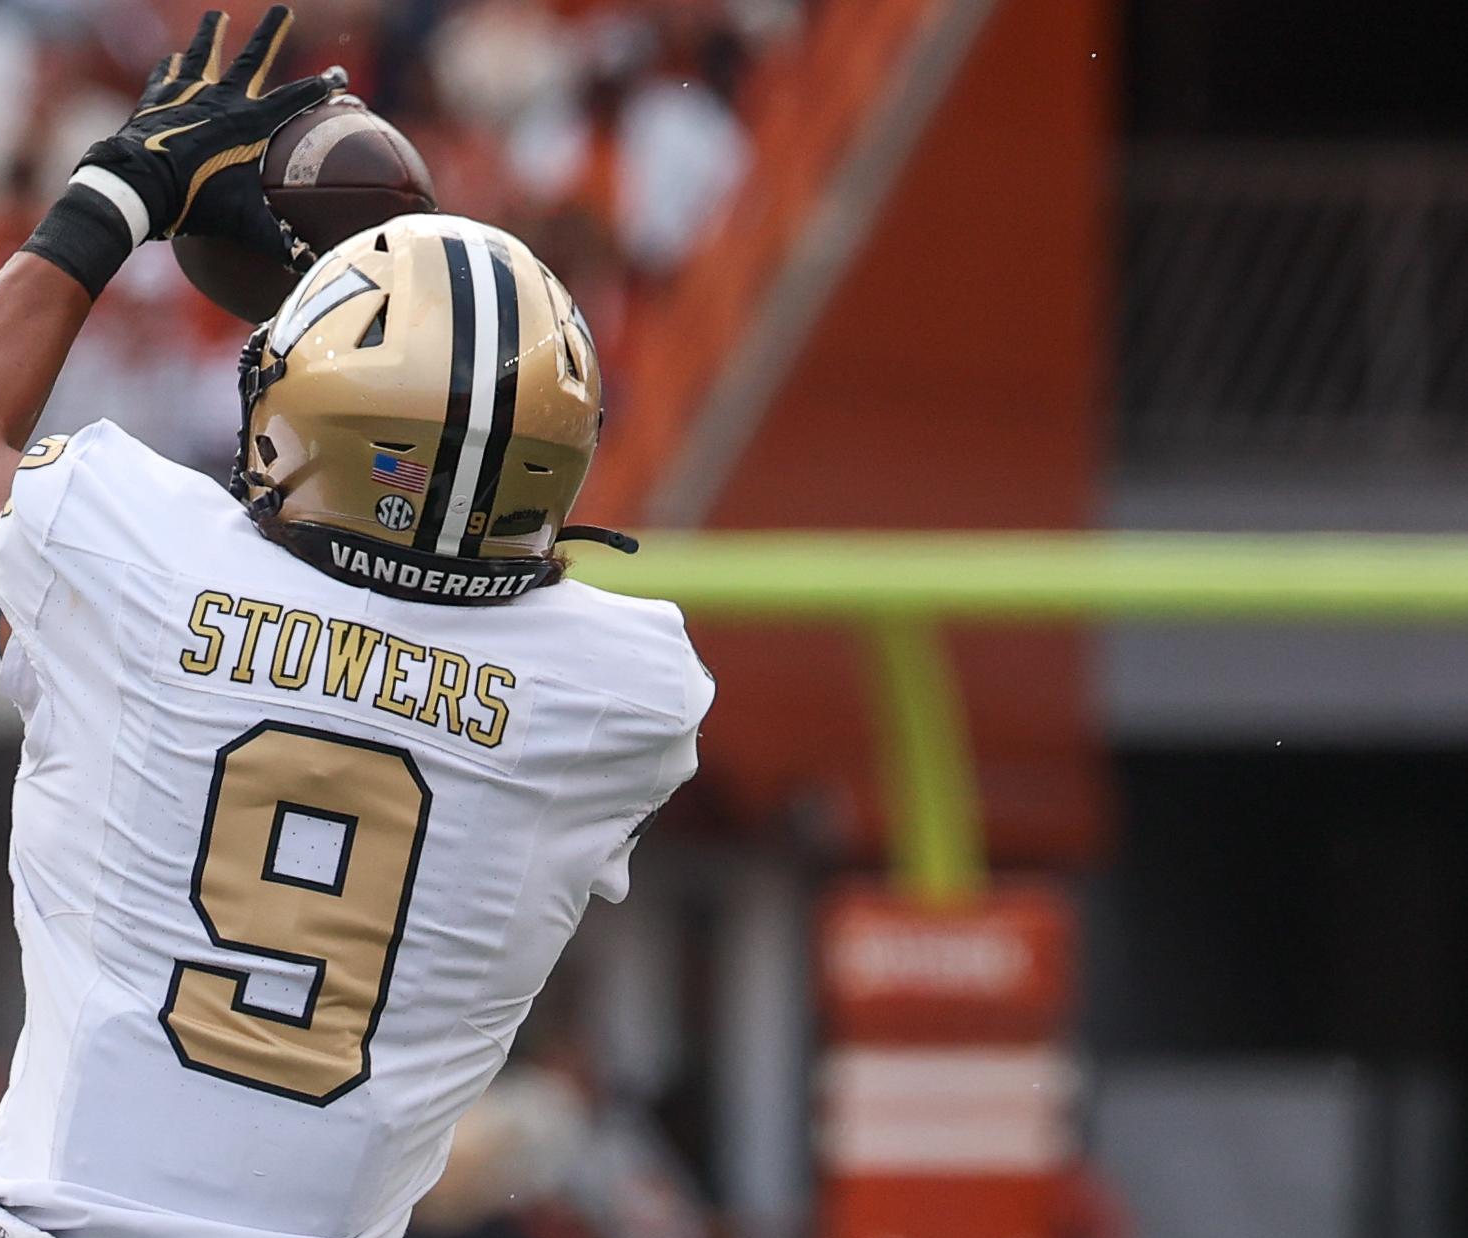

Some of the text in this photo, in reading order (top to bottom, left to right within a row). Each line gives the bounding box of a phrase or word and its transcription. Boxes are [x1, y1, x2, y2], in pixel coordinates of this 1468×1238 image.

[377, 496, 413, 530] SEC
[467, 511, 487, 536] 9
[331, 541, 536, 598] VANDERBILT
[180, 589, 516, 748] STOWERS
[158, 718, 434, 1108] 9
